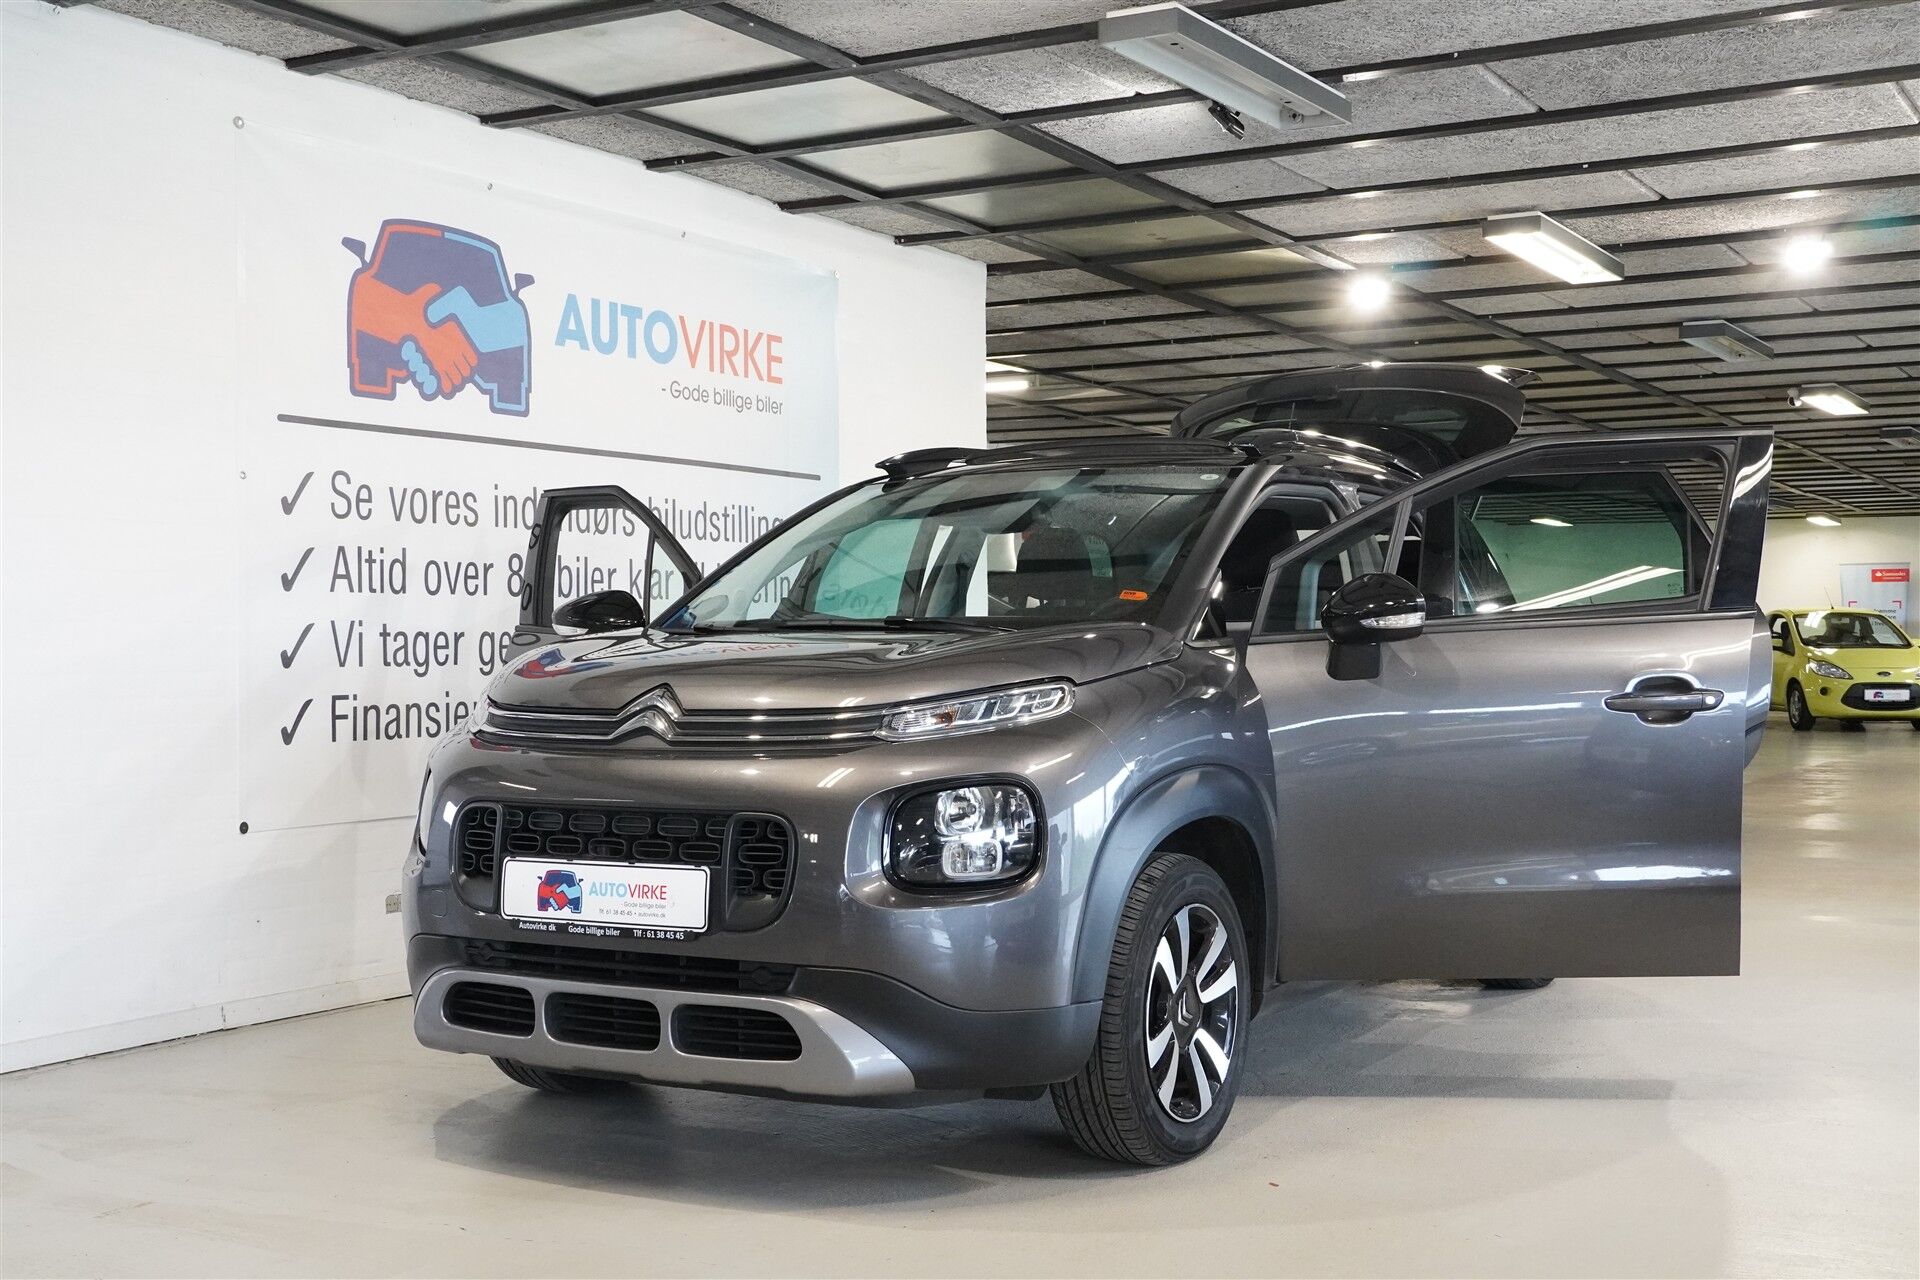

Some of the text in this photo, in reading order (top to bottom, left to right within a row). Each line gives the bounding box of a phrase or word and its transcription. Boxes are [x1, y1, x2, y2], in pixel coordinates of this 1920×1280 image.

[554, 293, 783, 384] AUTOVIRKE
[669, 380, 710, 403] Gode
[713, 387, 753, 413] billige
[756, 395, 783, 415] biler
[331, 470, 785, 543] Se vores inddørs biludstillin
[329, 545, 407, 595] Altid
[424, 556, 494, 596] over
[557, 554, 617, 599] biler
[629, 559, 674, 600] kar
[330, 620, 512, 677] Vi tager ge
[331, 691, 477, 742] Finansie
[589, 881, 667, 900] AUTOVIRKE
[519, 922, 547, 931] Autovirke
[568, 925, 621, 937] Gode billige biler
[646, 930, 655, 938] 61
[656, 931, 665, 939] 38
